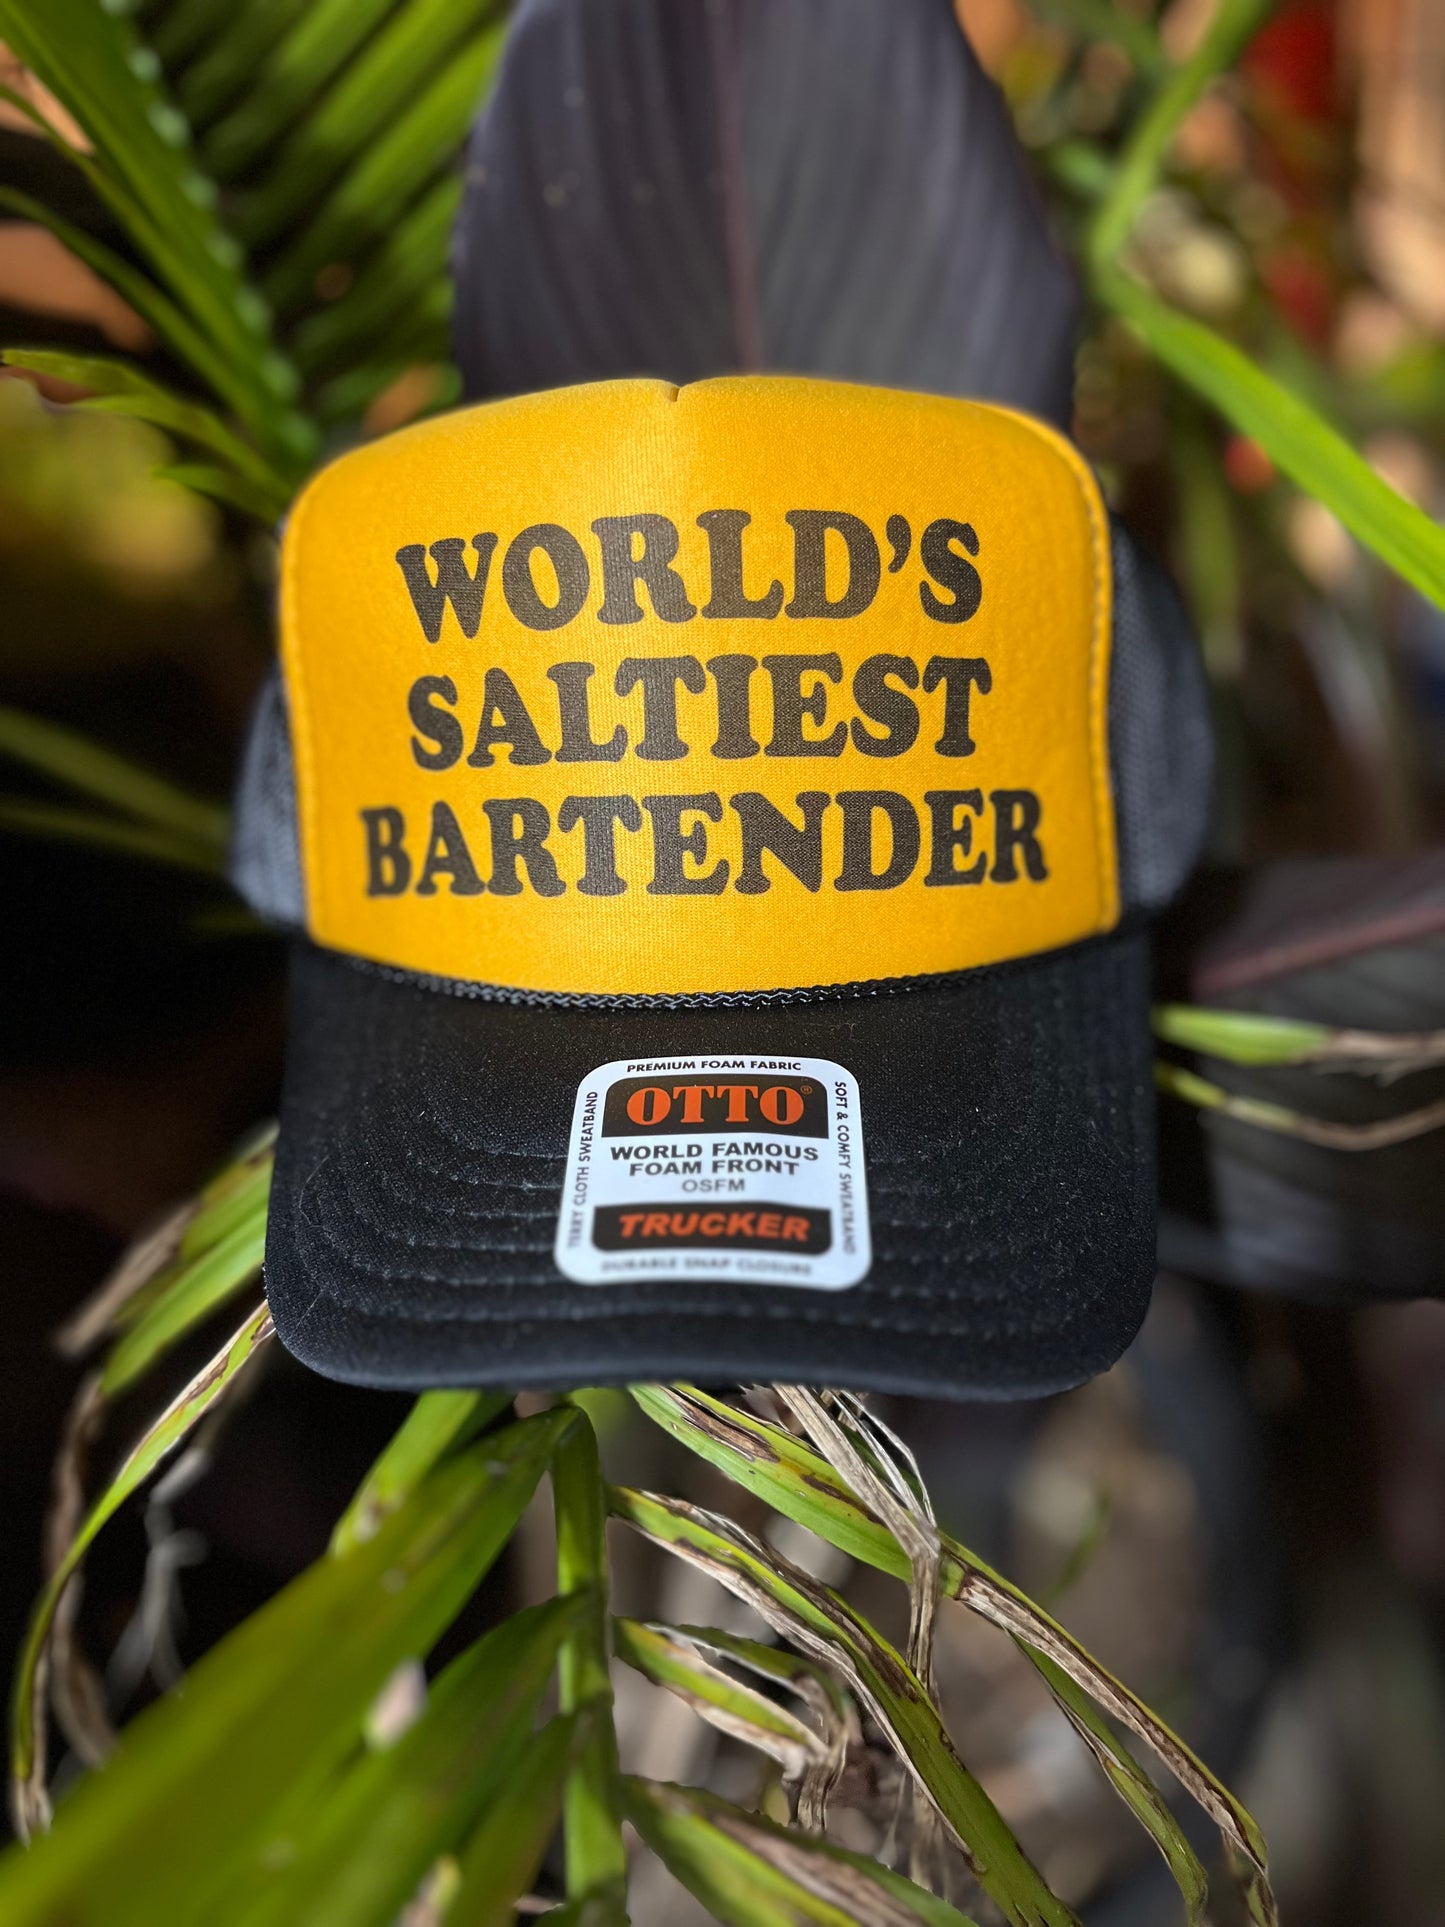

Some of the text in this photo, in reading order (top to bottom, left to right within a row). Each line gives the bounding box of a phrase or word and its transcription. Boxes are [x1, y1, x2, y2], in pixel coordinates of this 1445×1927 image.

[395, 508, 983, 644] WORLD'S
[407, 652, 993, 772] SALTIEST
[360, 788, 1049, 897] BARTENDER
[627, 1060, 802, 1073] PREMIUM FOAM FABRIC
[626, 1085, 805, 1126] OTTO
[835, 1081, 848, 1109] SOFT
[578, 1091, 599, 1162] SWEATBAND
[836, 1112, 849, 1120] &
[611, 1142, 819, 1161] WORLD FAMOUS
[837, 1124, 851, 1169] COMFY
[629, 1159, 800, 1177] FOAM FRONT
[573, 1166, 590, 1207] CLOTH
[681, 1179, 746, 1194] OSFM
[619, 1212, 811, 1242] TRUCKER
